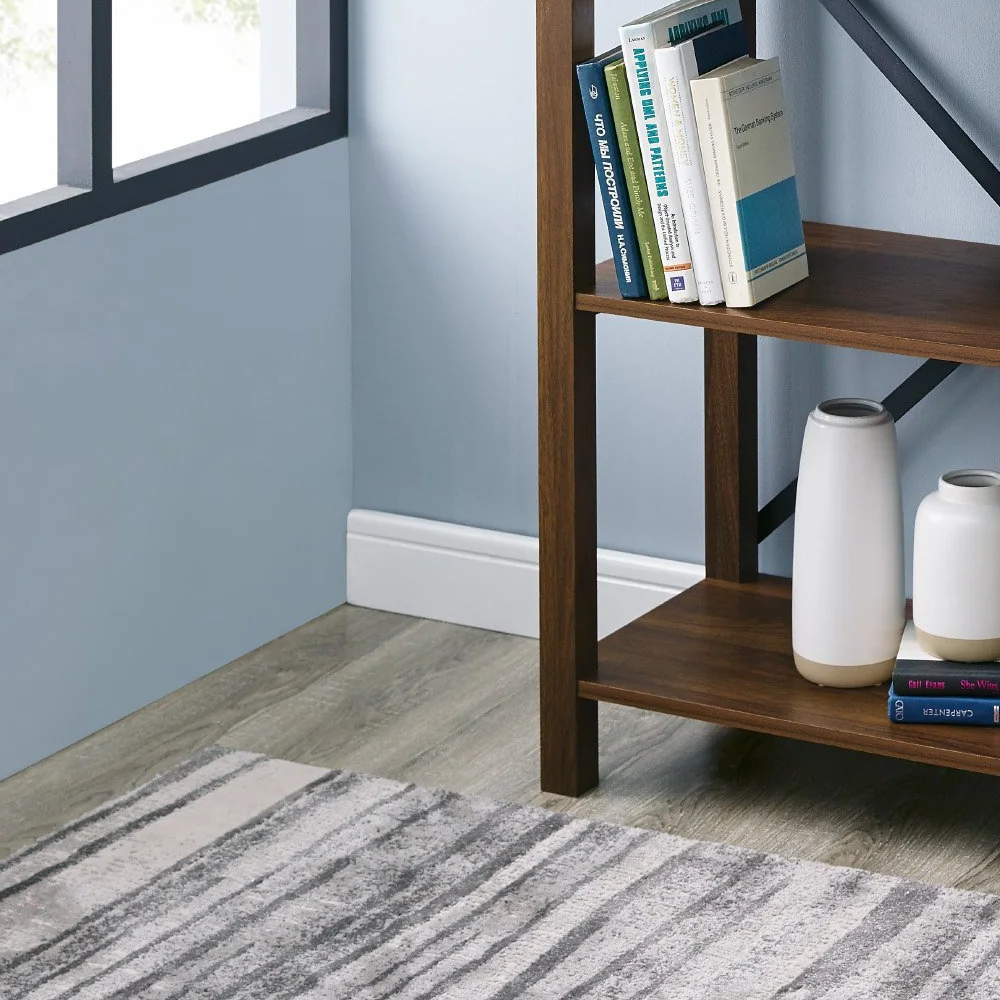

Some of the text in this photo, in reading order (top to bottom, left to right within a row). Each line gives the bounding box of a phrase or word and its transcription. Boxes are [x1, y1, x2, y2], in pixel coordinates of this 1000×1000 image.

[594, 113, 606, 137] ЧТО
[633, 47, 669, 197] APPLYING UML AND PATTERNS
[598, 138, 611, 160] МЫ
[603, 160, 624, 231] ПОСТРОИЛИ
[960, 679, 975, 690] She
[894, 699, 904, 720] CATO
[922, 708, 974, 718] CARPENTER
